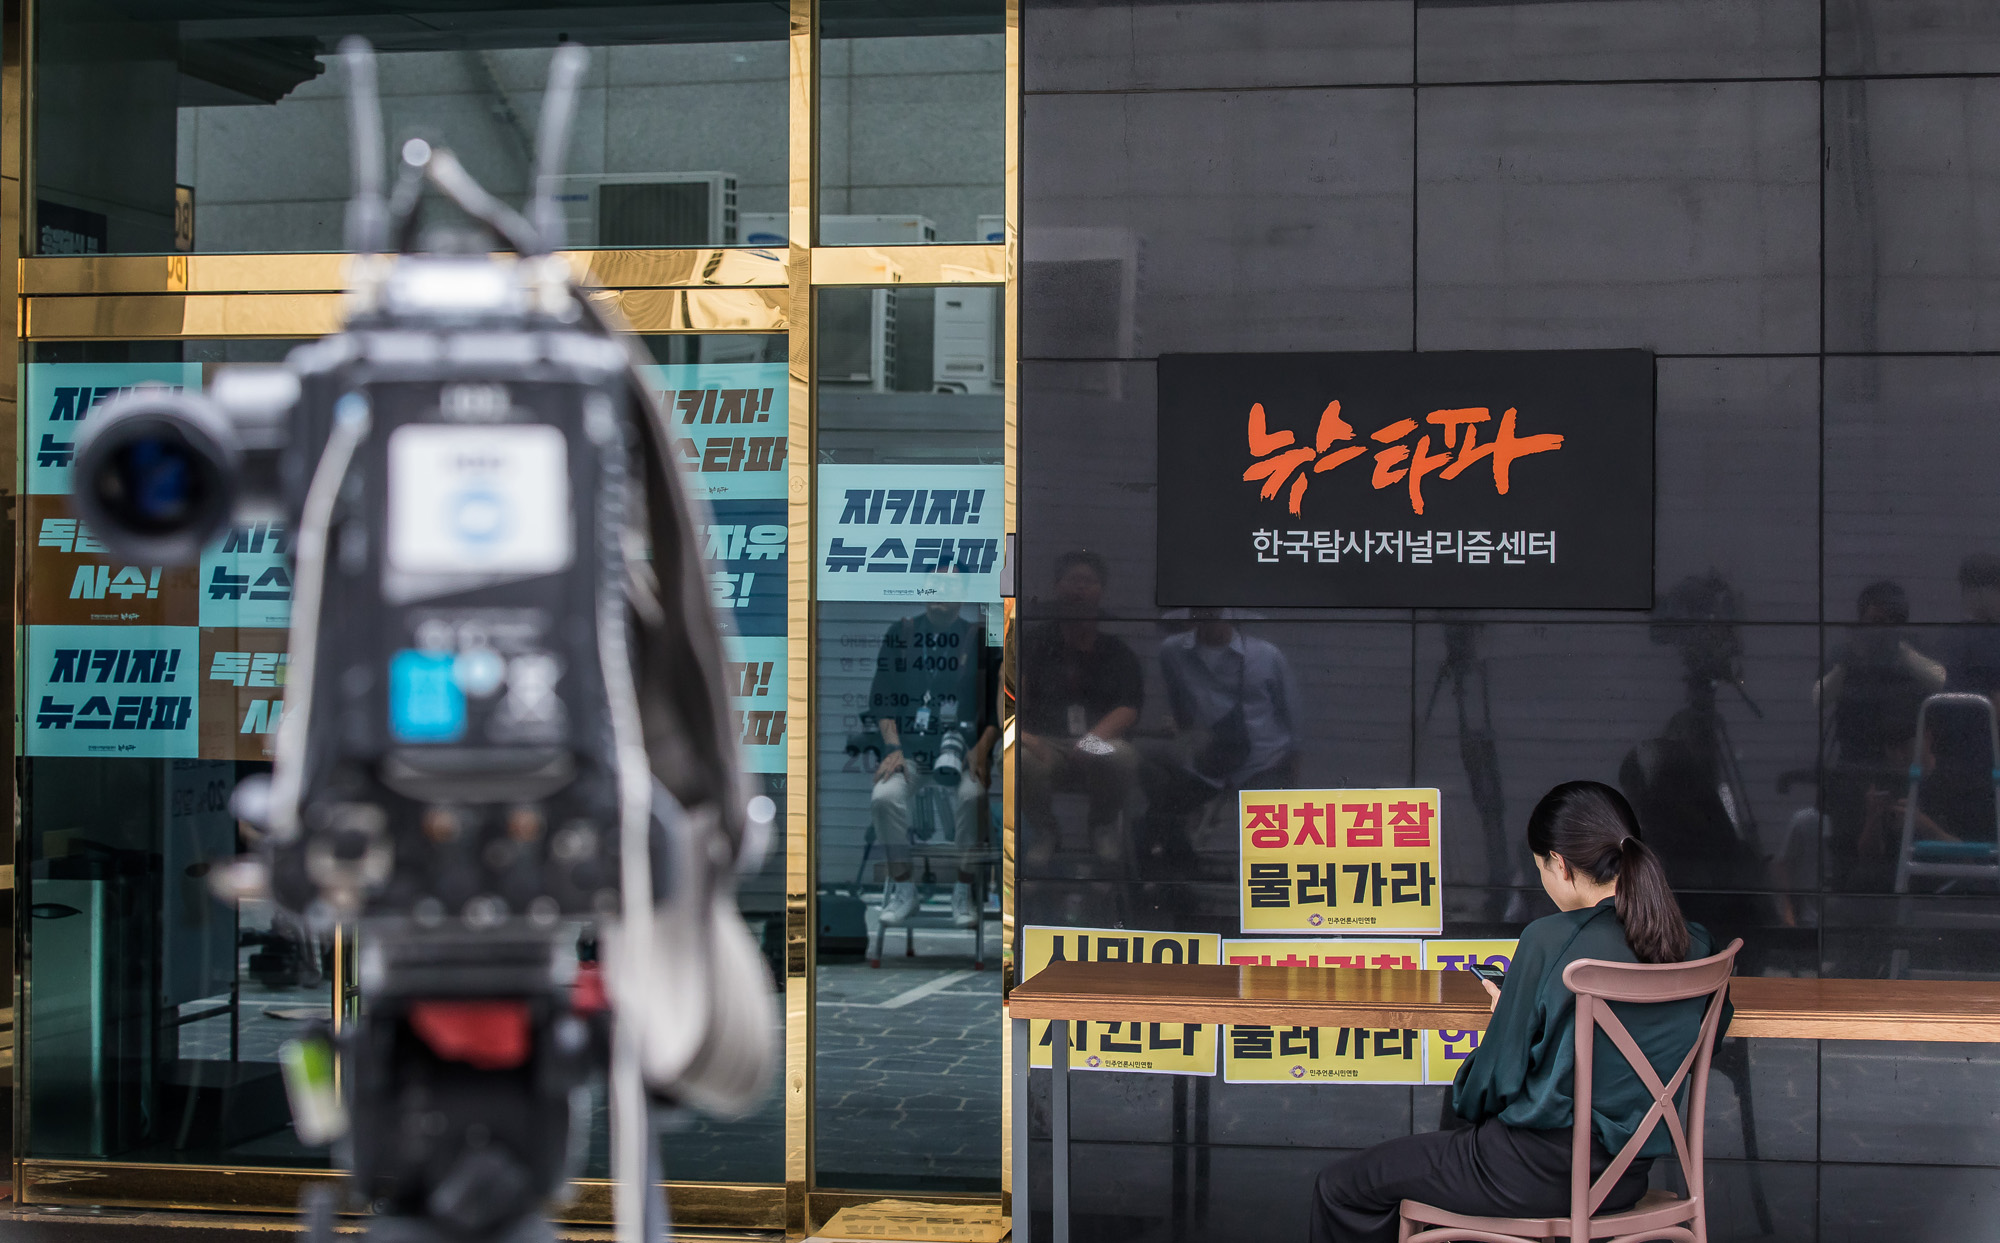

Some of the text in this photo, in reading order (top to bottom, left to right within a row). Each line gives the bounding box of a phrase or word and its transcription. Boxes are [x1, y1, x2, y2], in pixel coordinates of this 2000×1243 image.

[672, 436, 788, 472] 스타파
[1243, 399, 1565, 519] 뉴스타파
[839, 489, 986, 525] 지키자!
[825, 537, 999, 574] 뉴스타파
[1252, 527, 1556, 564] 한국탐사저널리즘센터
[69, 565, 163, 600] 사수!
[49, 649, 181, 683] 지키자!
[36, 696, 192, 730] 뉴스타파
[1245, 801, 1435, 848] 정치검찰
[1247, 862, 1436, 908] 물러가라
[1327, 917, 1377, 925] 민주언론시민연합
[1104, 1060, 1153, 1069] 민주언론시민연합
[1309, 1069, 1359, 1078] 민주언론시민연합
